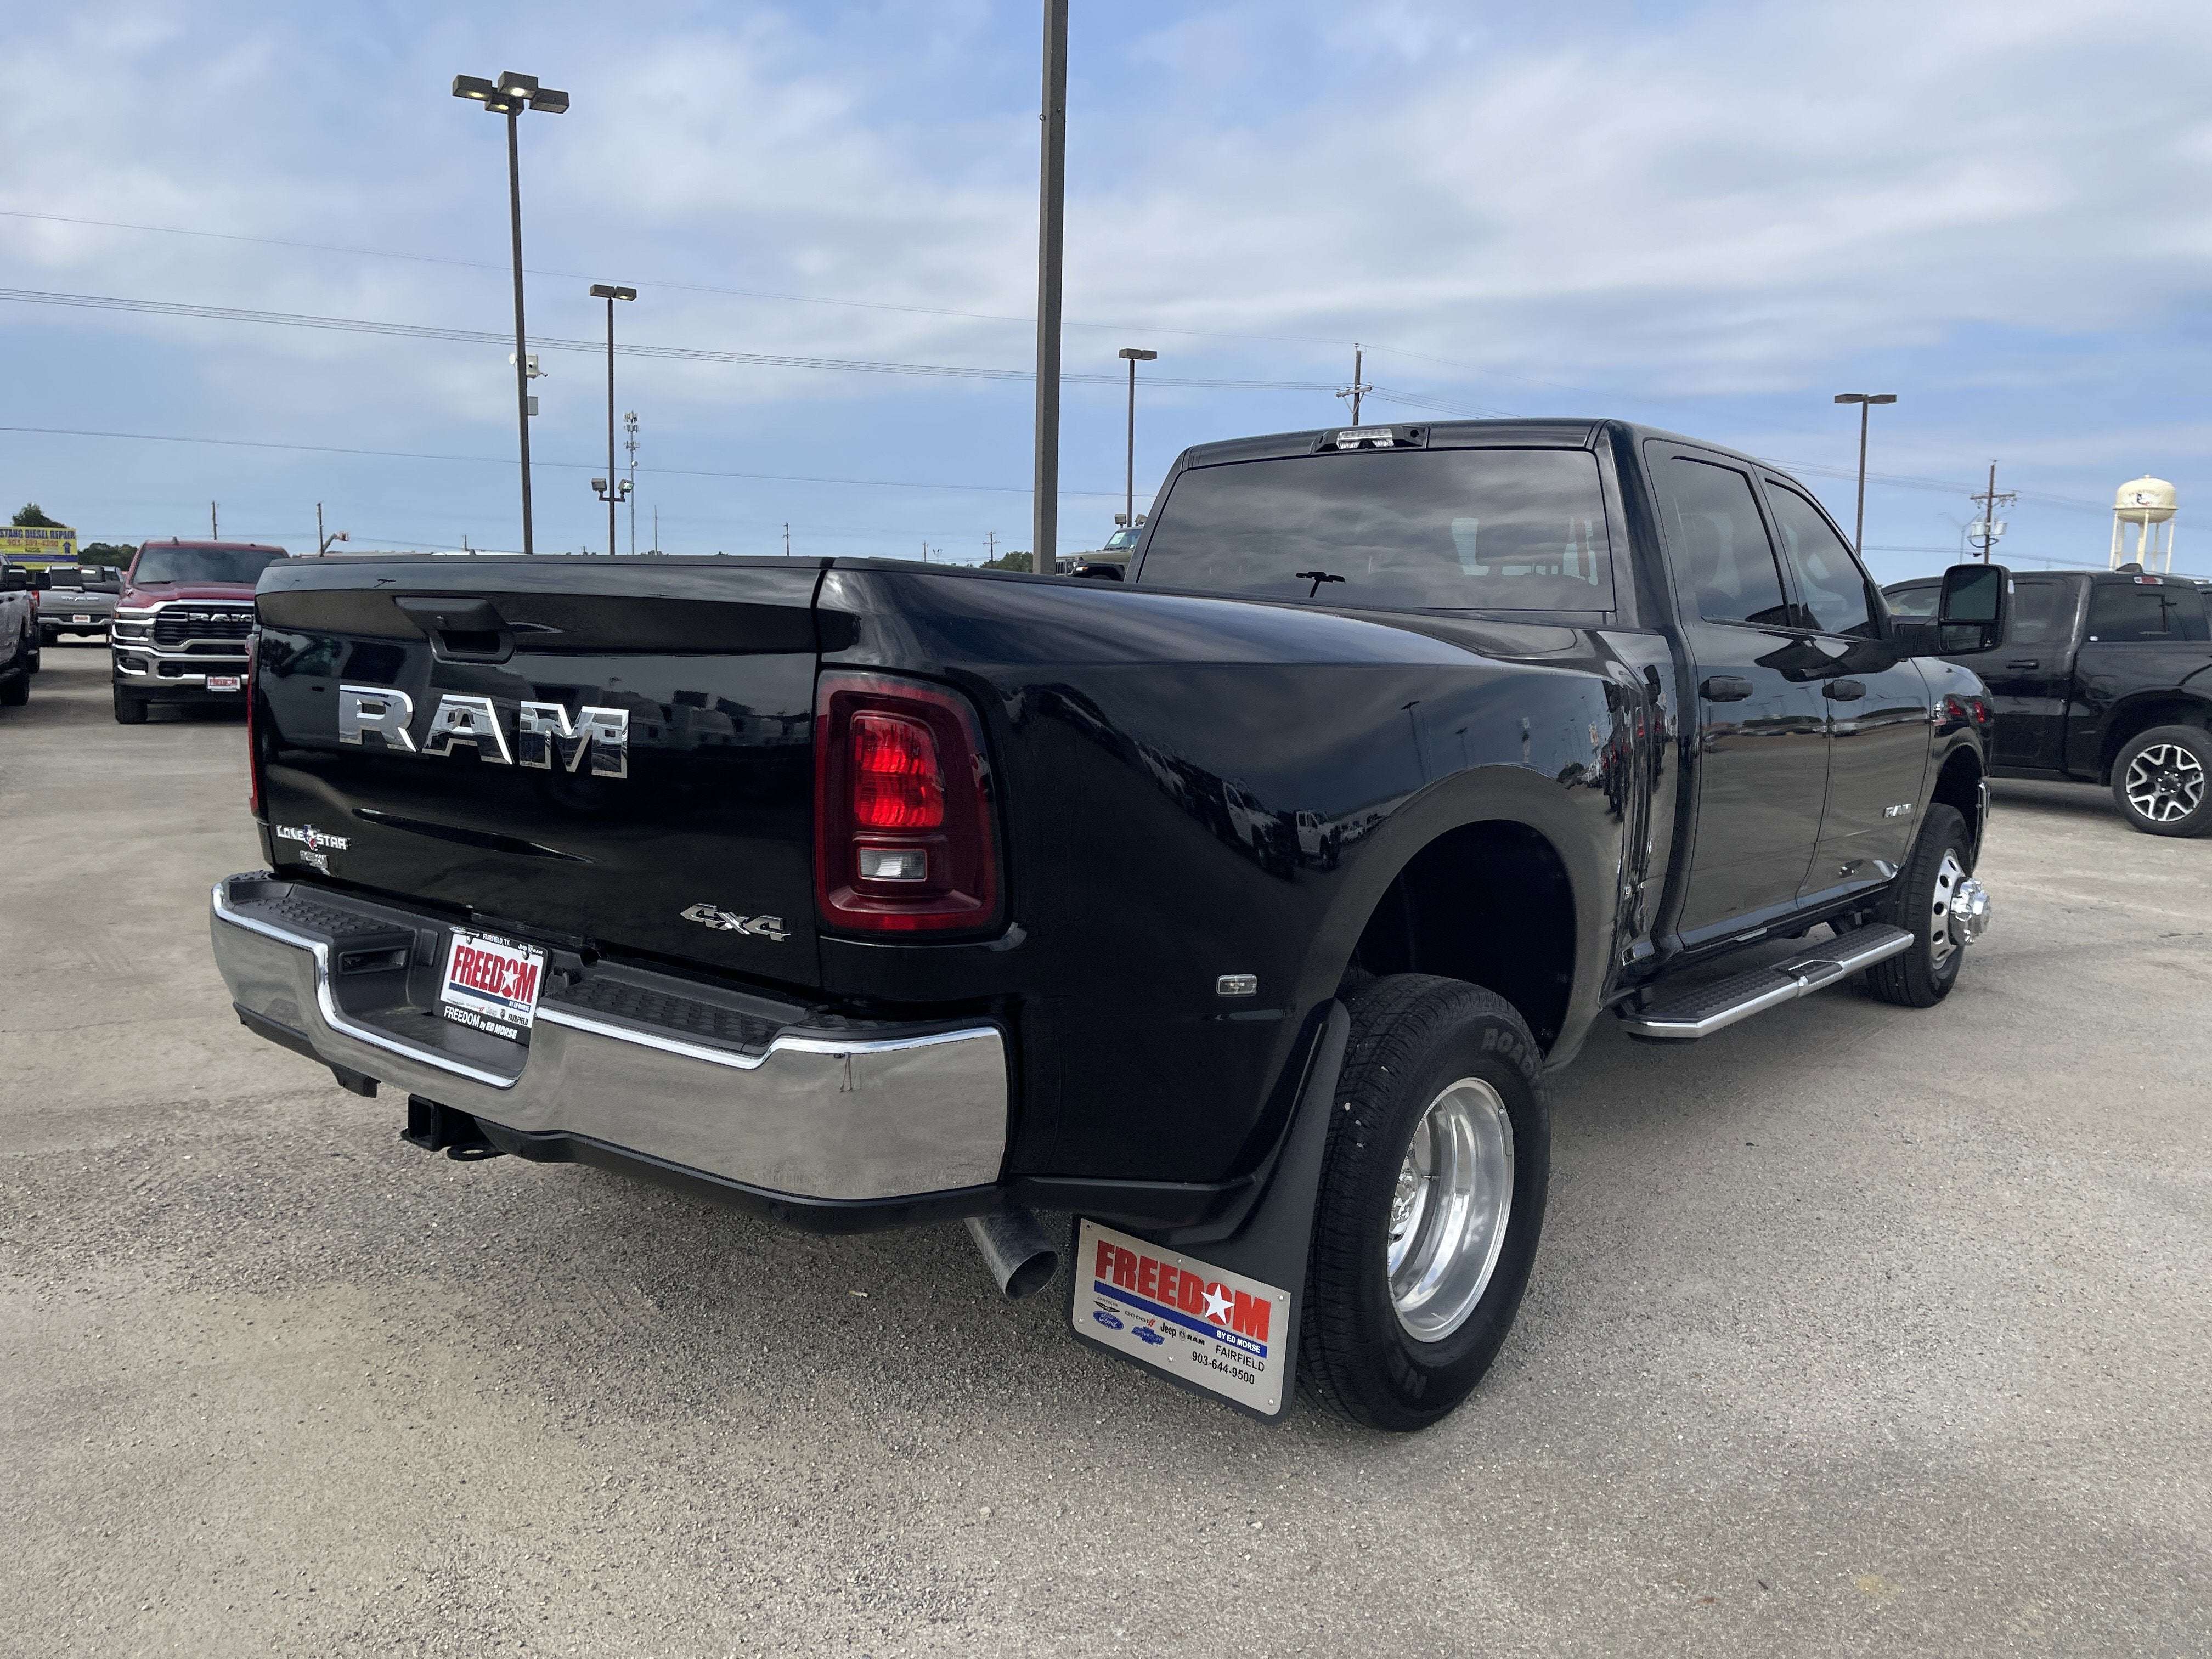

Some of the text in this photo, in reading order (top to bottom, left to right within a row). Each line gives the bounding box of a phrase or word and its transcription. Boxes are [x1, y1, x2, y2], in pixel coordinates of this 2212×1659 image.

[25, 529, 48, 539] DIESEL
[50, 531, 75, 539] REPAIR
[189, 613, 252, 622] RAM
[338, 685, 630, 779] RAM
[1883, 803, 1911, 818] RAM
[276, 825, 348, 850] LONE STAR
[450, 945, 538, 1003] FREEDOM
[444, 1006, 518, 1039] FREEDOM by ED MORSE
[508, 1014, 528, 1025] FAIRFIELD
[1095, 1240, 1271, 1342] FREEDOM
[1099, 1313, 1117, 1328] Ford
[1160, 1322, 1176, 1339] Jeep
[1187, 1334, 1205, 1346] RAM
[1217, 1330, 1261, 1353] BY ED MORSE
[1192, 1351, 1255, 1384] 903-644-9500
[1216, 1345, 1265, 1372] FAIRFIELD
